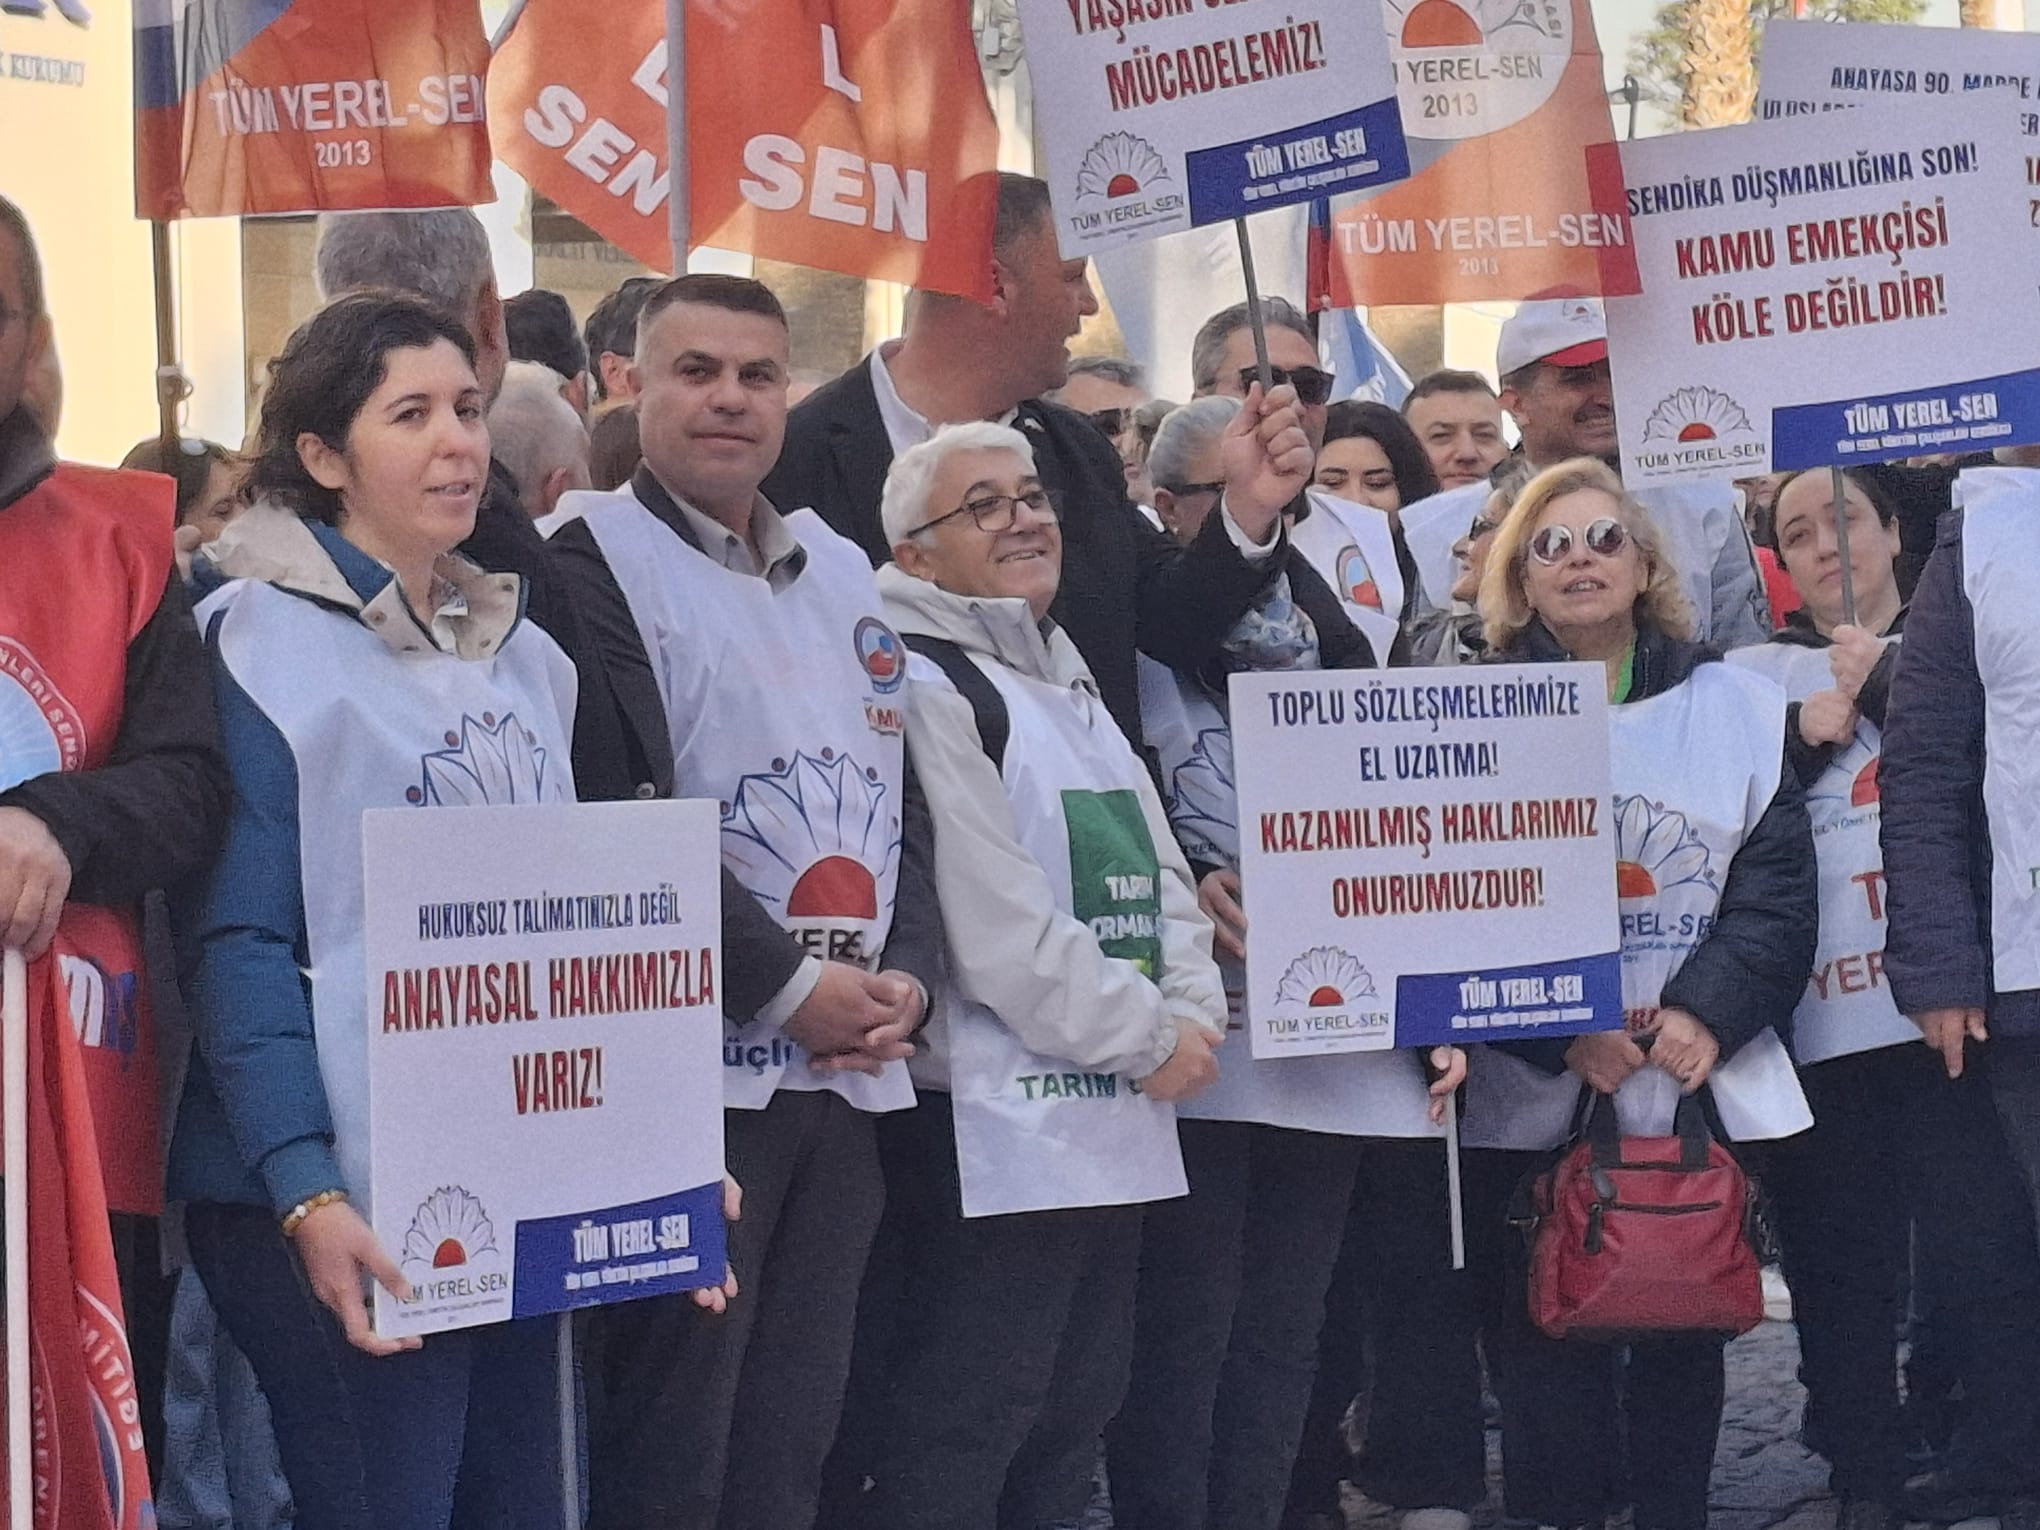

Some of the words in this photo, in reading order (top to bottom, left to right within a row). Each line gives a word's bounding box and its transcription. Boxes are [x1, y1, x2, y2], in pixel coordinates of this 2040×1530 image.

[1105, 15, 1327, 112] MÜCADELEMİZ!
[1406, 55, 1543, 84] YEREL-SEN
[1831, 66, 1917, 93] ANAYASA
[208, 77, 279, 137] TÜM
[1422, 92, 1479, 118] 2013
[315, 139, 371, 168] 2013
[1246, 143, 1284, 181] TÜM
[739, 133, 928, 242] SEN
[1626, 174, 1725, 217] SENDİKA
[1732, 150, 1914, 209] DÜŞMANLIĞINA
[1921, 142, 1980, 177] SON!
[1336, 213, 1416, 255] TÜM
[1424, 213, 1626, 251] YEREL-SEN
[1674, 227, 1776, 280] KAMU
[1786, 195, 1949, 267] EMEKÇİSİ
[1691, 292, 1775, 345] KÖLE
[1785, 270, 1948, 334] DEĞİLDİR!
[1844, 401, 1889, 436] TÜM
[1893, 393, 1999, 430] YEREL-SEN
[1634, 450, 1670, 469] TÜM
[1673, 443, 1767, 466] YEREL-SEN
[1268, 689, 1345, 728] TOPLU
[1354, 674, 1581, 733] SÖZLEŞMELERİMİZE
[1359, 746, 1387, 782] EL
[1394, 741, 1500, 780] UZATMA!
[1259, 806, 1432, 860] KAZANILMIŞ
[1441, 798, 1600, 844] HAKLARIMIZ
[419, 899, 508, 942] HUKUKSUZ
[513, 890, 634, 935] TALİMATINIZLA
[639, 882, 682, 926] DEĞİL
[1331, 867, 1546, 919] ONURUMUZDUR!
[382, 960, 538, 1034] ANAYASAL
[548, 947, 715, 1020] HAKKIMIZLA
[1459, 975, 1497, 1010] TÜM
[1500, 974, 1584, 1006] YEREL-SEN
[1266, 1015, 1301, 1035] TÜM
[1304, 1012, 1389, 1031] YEREL-SEN
[512, 1047, 605, 1115] VARIZ!
[1016, 1072, 1117, 1101] TARIM
[572, 1219, 609, 1263] TÜM
[610, 1213, 690, 1258] YEREL-SEN
